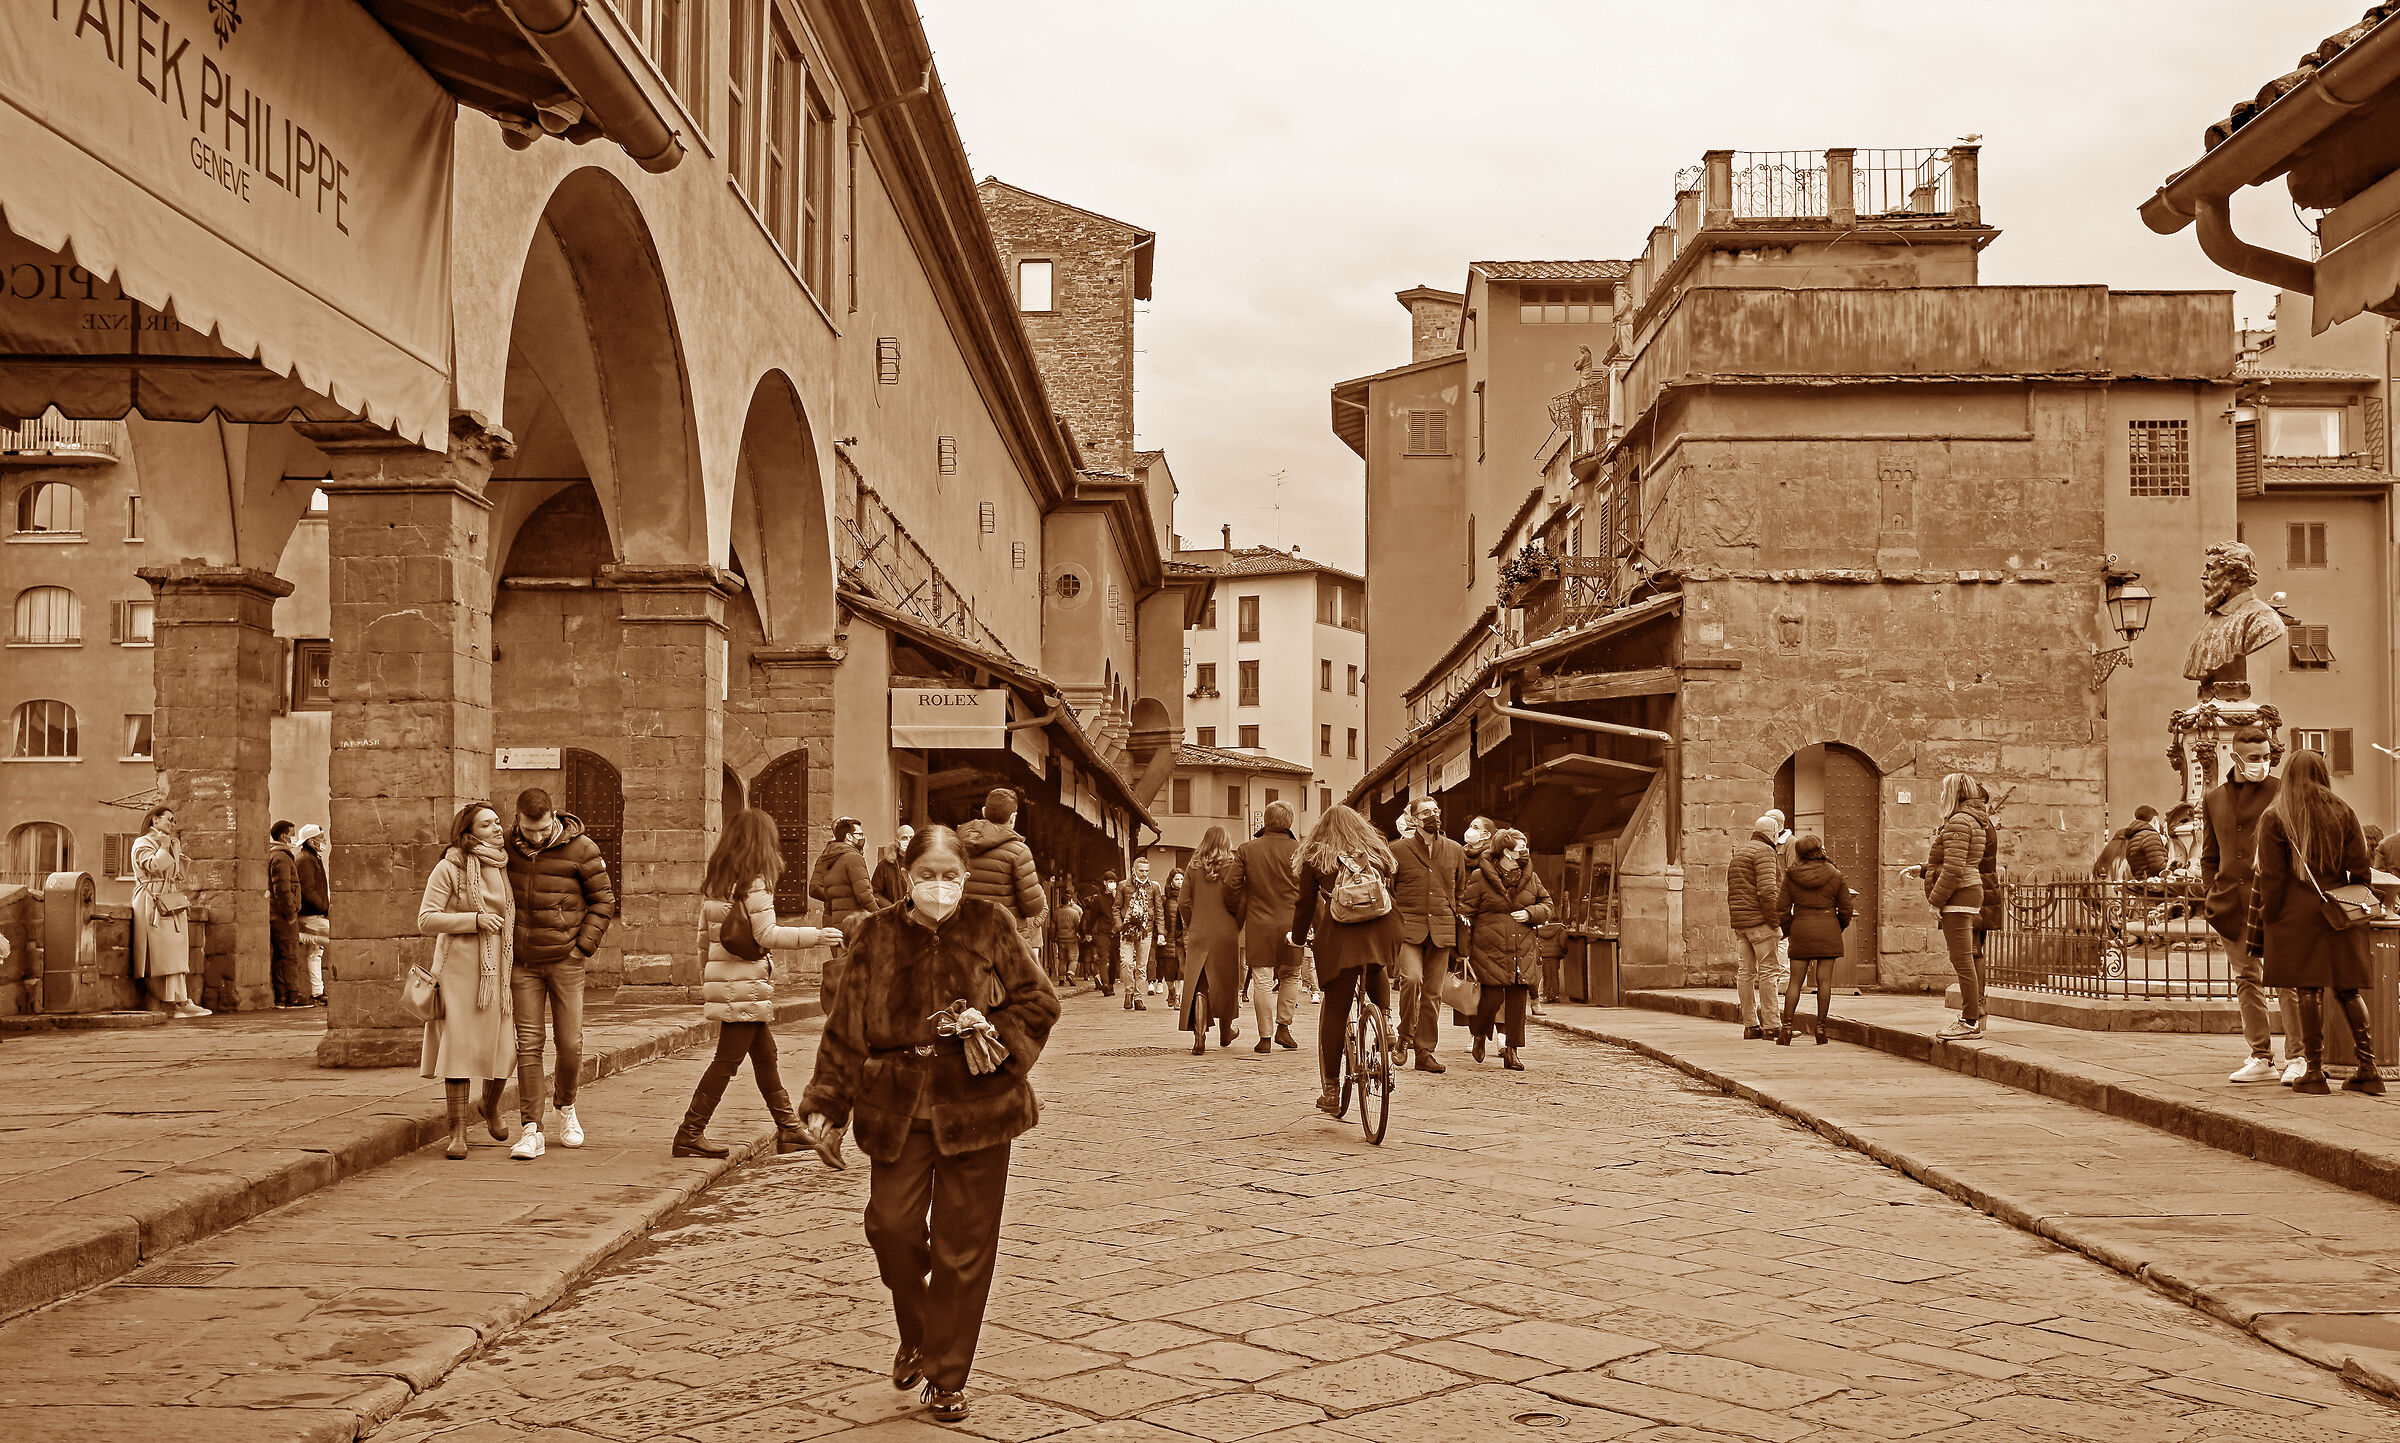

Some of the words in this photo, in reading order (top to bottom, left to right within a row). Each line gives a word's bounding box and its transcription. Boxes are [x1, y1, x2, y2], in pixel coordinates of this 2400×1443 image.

[52, 0, 190, 121] ATEK
[200, 54, 350, 237] PHILIPPE
[190, 137, 250, 203] GENEVE
[918, 694, 979, 706] ROLEX
